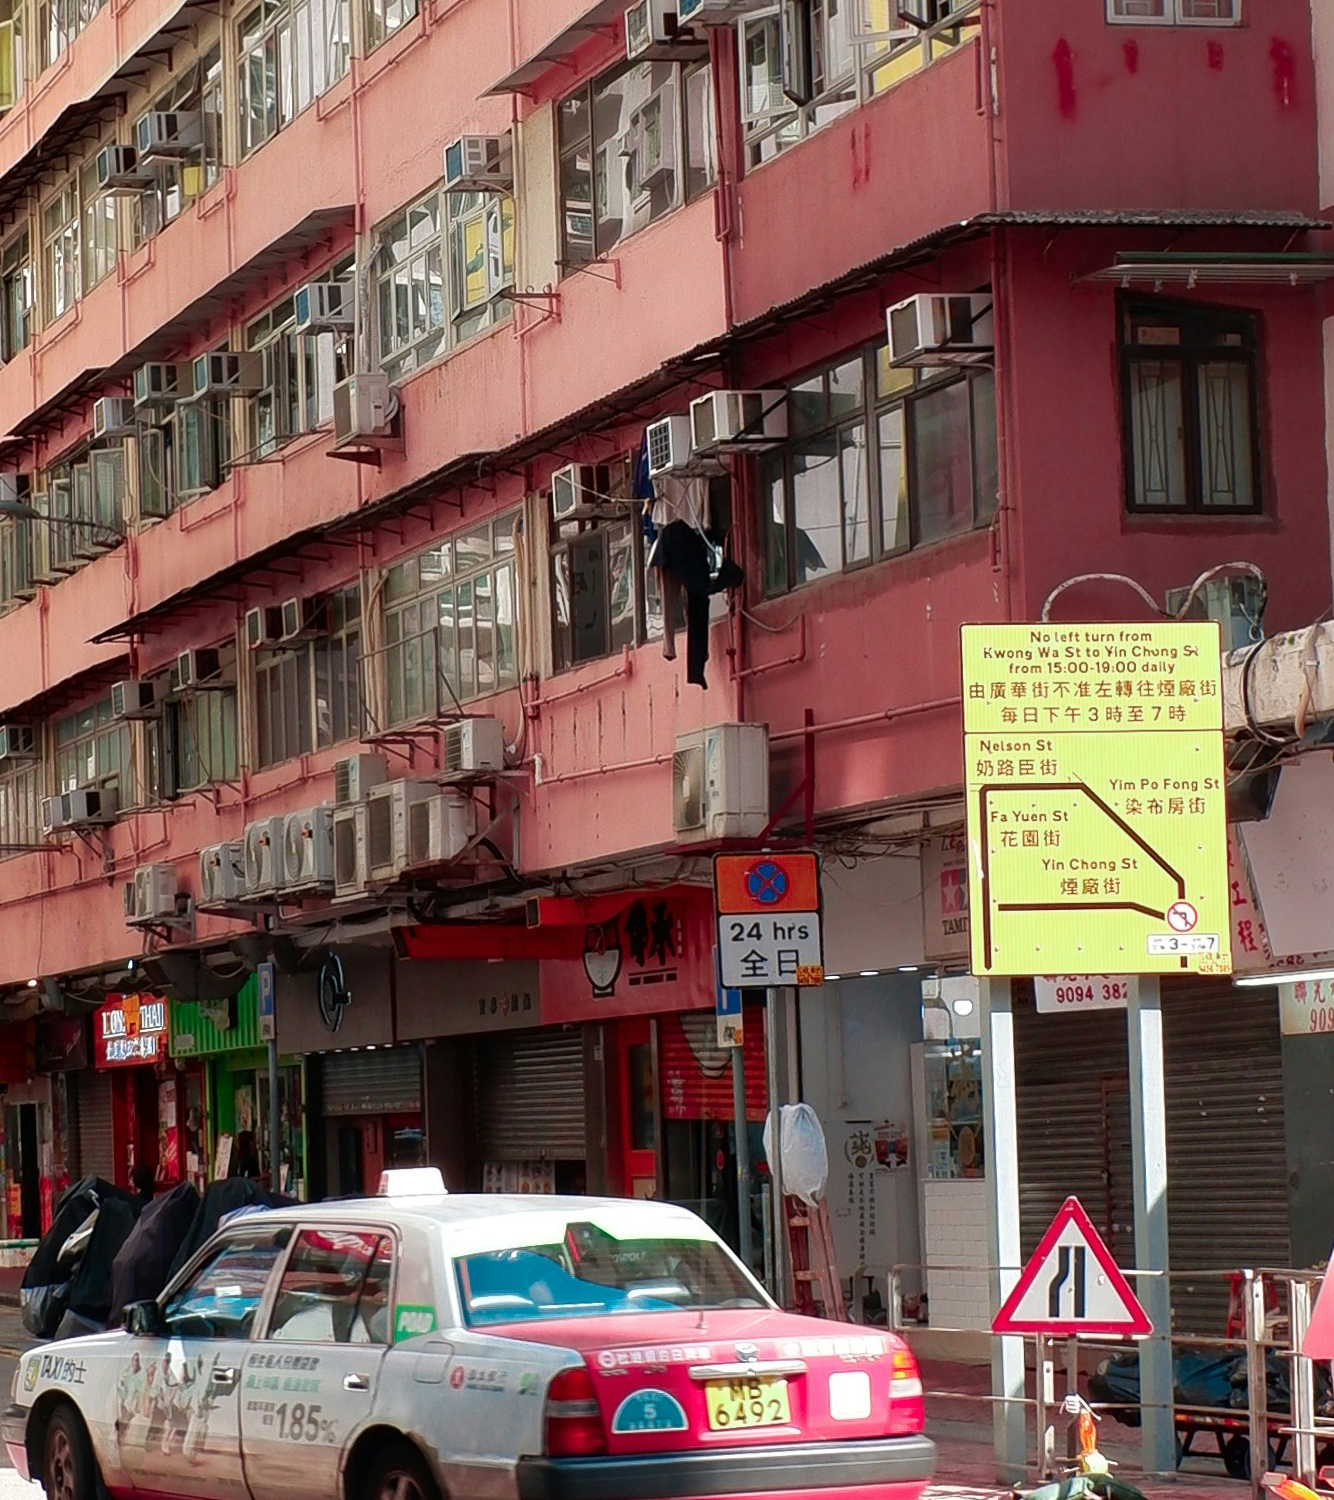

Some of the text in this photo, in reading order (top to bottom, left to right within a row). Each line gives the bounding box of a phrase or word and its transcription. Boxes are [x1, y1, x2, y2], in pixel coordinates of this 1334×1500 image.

[1031, 630, 1152, 643] No left turn from
[983, 647, 1033, 660] Kwong
[1038, 647, 1060, 658] Wa
[1064, 646, 1083, 658] St
[1086, 647, 1100, 658] to
[1104, 646, 1127, 658] Yin
[1009, 660, 1176, 674] from 15:00-19:00 daily
[979, 739, 1054, 752] Nelson St
[975, 758, 1058, 778] 奶路臣街
[1109, 777, 1220, 792] Yim Po Fong St
[1124, 796, 1207, 816] 染布房街
[990, 810, 1070, 823] Fa Yuen St
[1000, 829, 1061, 848] 花園街
[1041, 857, 1139, 872] Yin Chong St
[1059, 877, 1122, 896] 煙廠街
[729, 920, 810, 942] 24 hrs
[740, 948, 799, 978] 全日
[1055, 983, 1095, 1005] 9094
[41, 1354, 87, 1385] TAXI 的士
[729, 1377, 763, 1402] MB
[715, 1399, 784, 1427] 6492
